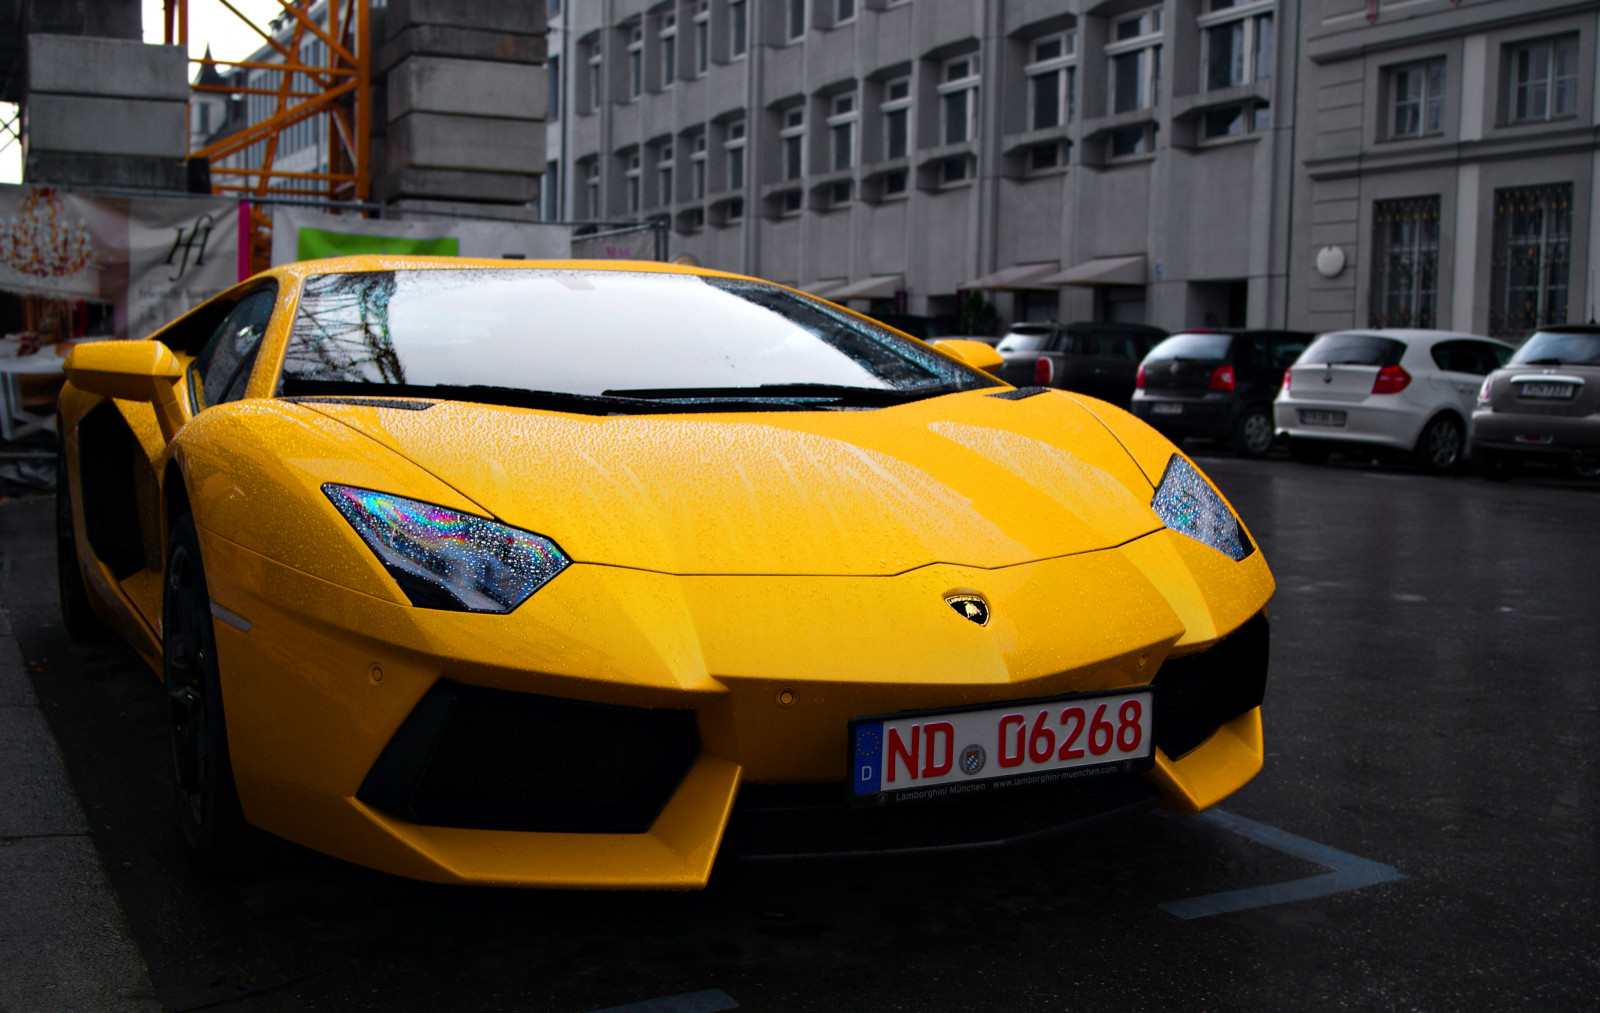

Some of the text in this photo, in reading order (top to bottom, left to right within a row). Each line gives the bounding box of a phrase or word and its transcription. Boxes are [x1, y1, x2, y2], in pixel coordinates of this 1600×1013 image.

[887, 722, 954, 782] ND
[861, 766, 872, 781] D
[896, 765, 1117, 801] Lamborghini München www.lamborghini-muenchen.com
